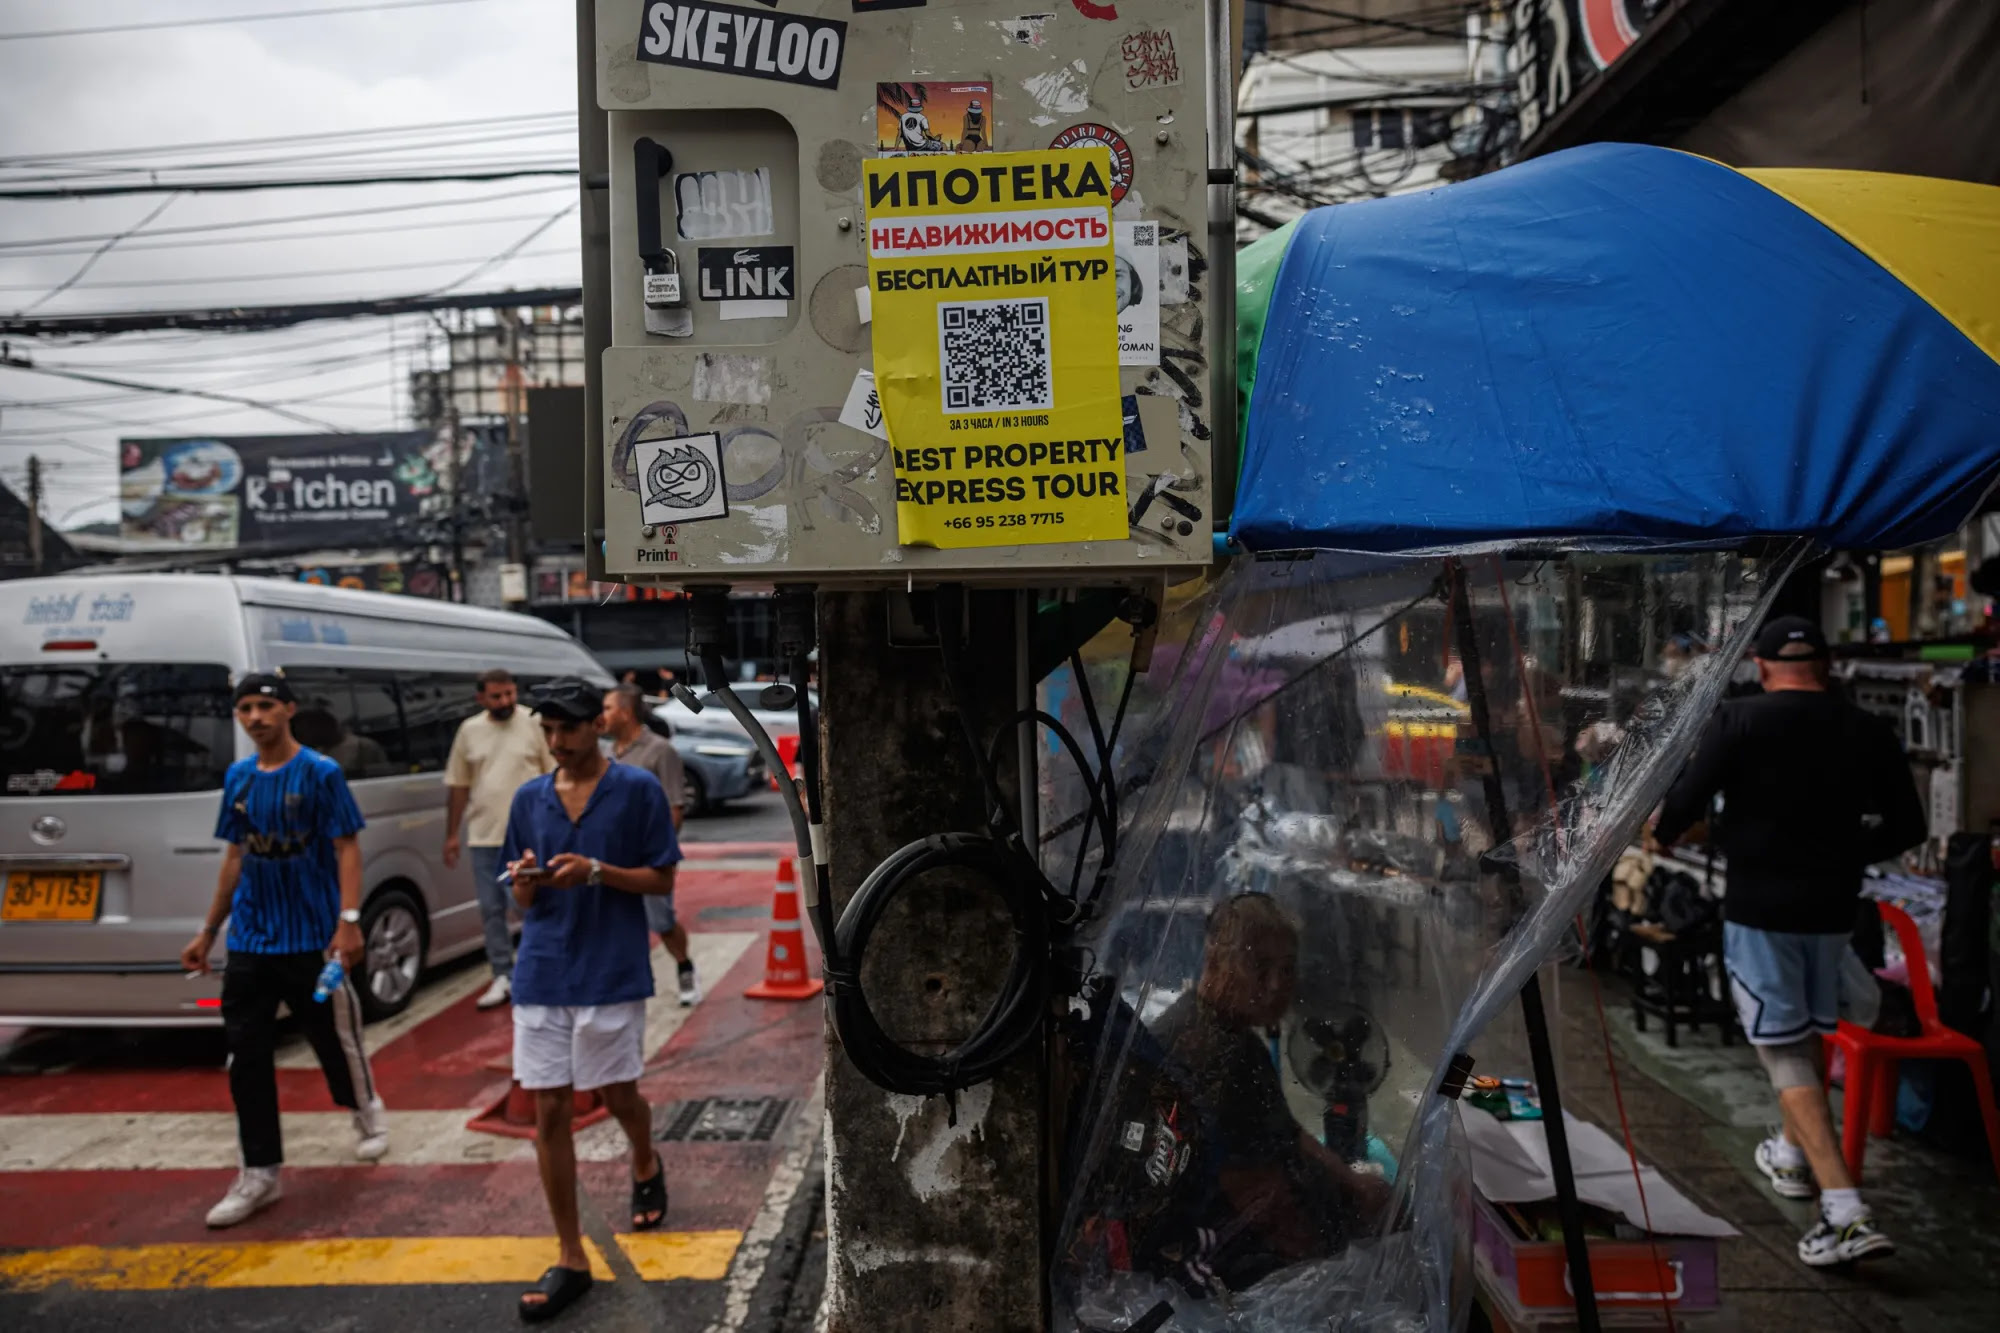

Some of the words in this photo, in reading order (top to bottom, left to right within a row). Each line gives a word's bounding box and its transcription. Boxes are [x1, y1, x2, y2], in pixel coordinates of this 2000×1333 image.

[644, 2, 840, 81] SKEYLOO
[1053, 127, 1096, 149] DARD
[869, 161, 1109, 209] ИПОТЕКА
[872, 217, 1108, 250] НЕДВИЖИМОСТЬ
[702, 266, 790, 298] LINK
[876, 256, 1057, 292] БЕСПЛАТНЫЙ
[1060, 259, 1109, 282] ТУР
[1118, 324, 1133, 333] NG
[1002, 416, 1012, 428] IN
[1013, 416, 1019, 427] 3
[1020, 414, 1049, 427] HOURS
[964, 438, 1122, 470] PROPERTY
[896, 476, 1026, 506] EXPRESS
[1032, 471, 1120, 500] TOUR
[943, 517, 972, 530] +66
[975, 515, 995, 529] 95
[998, 514, 1027, 528] 238
[1030, 512, 1065, 525] 7715
